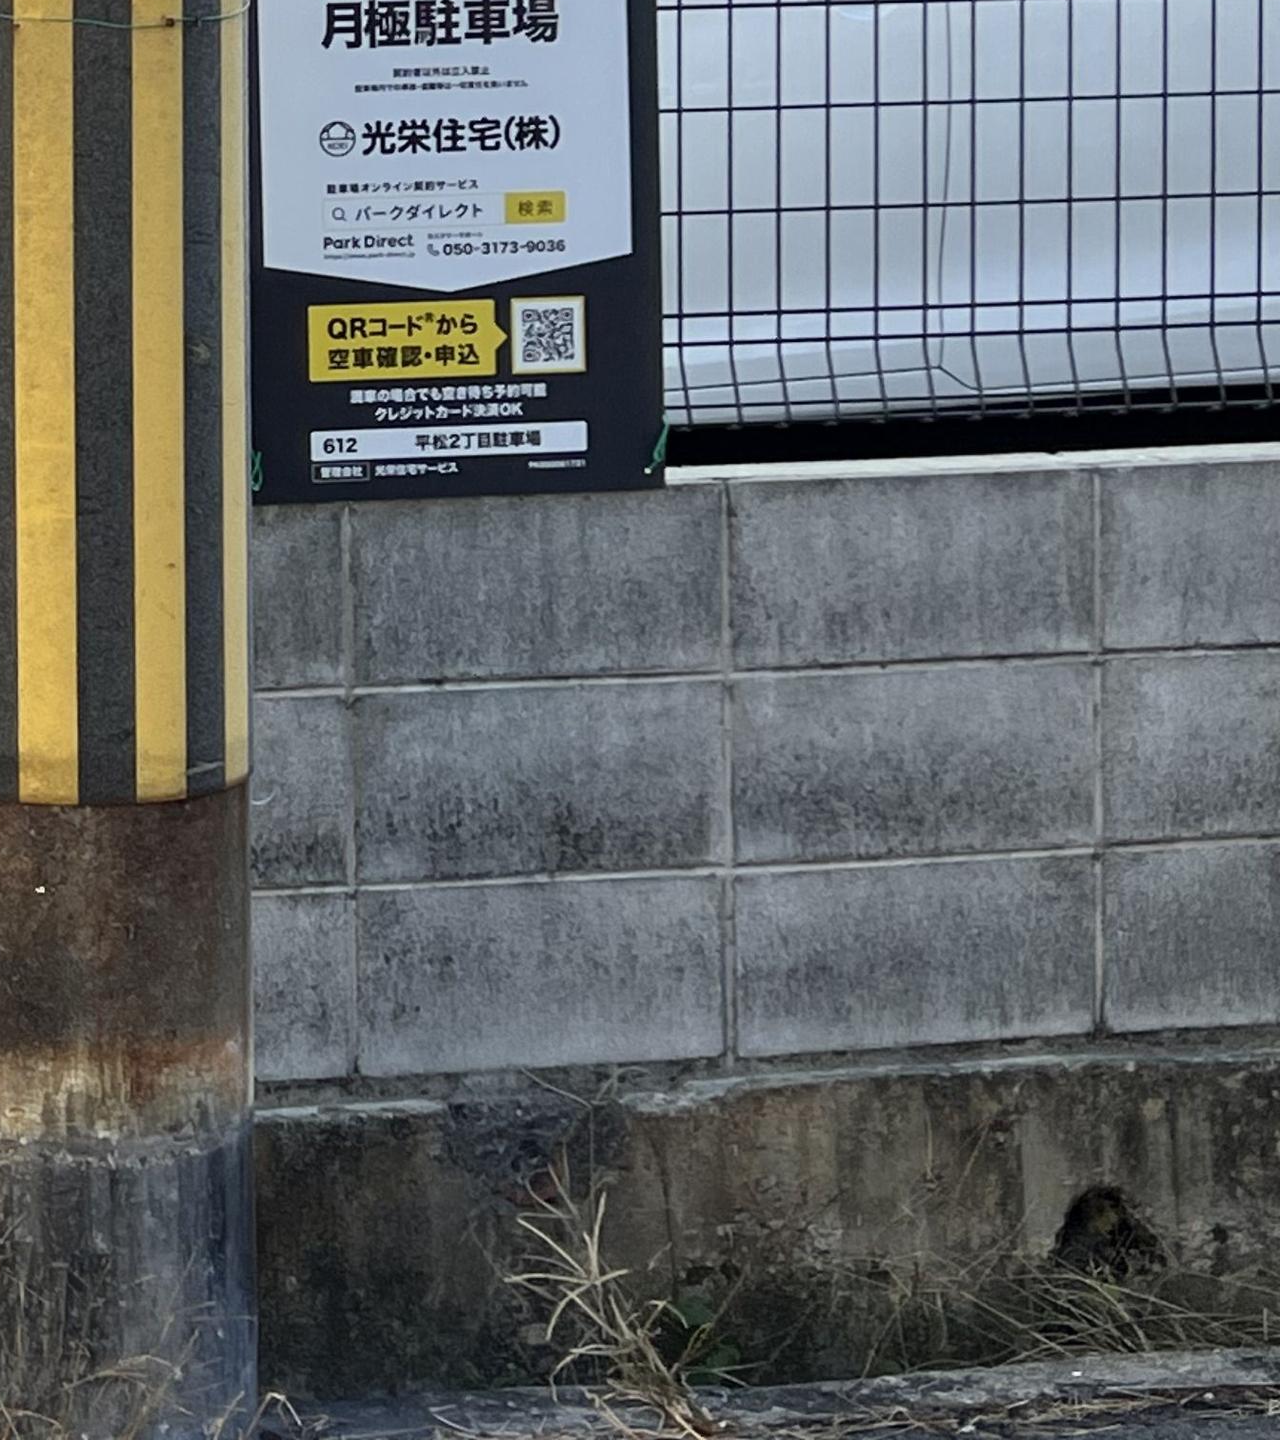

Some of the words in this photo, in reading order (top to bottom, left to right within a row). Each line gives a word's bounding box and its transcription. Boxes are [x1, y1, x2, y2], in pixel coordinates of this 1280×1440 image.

[361, 114, 561, 156] 光栄住宅(株)
[326, 179, 479, 195] 駐車場オンライン契約サービス
[355, 203, 484, 222] パークダイレクト
[517, 199, 554, 217] 検索
[323, 235, 361, 250] Park
[364, 233, 415, 249] Direct
[443, 238, 567, 257] 050-3173-9036
[327, 342, 481, 371] 空車確認・申込
[322, 437, 359, 455] 612
[415, 429, 542, 452] 平松2丁目駐車場
